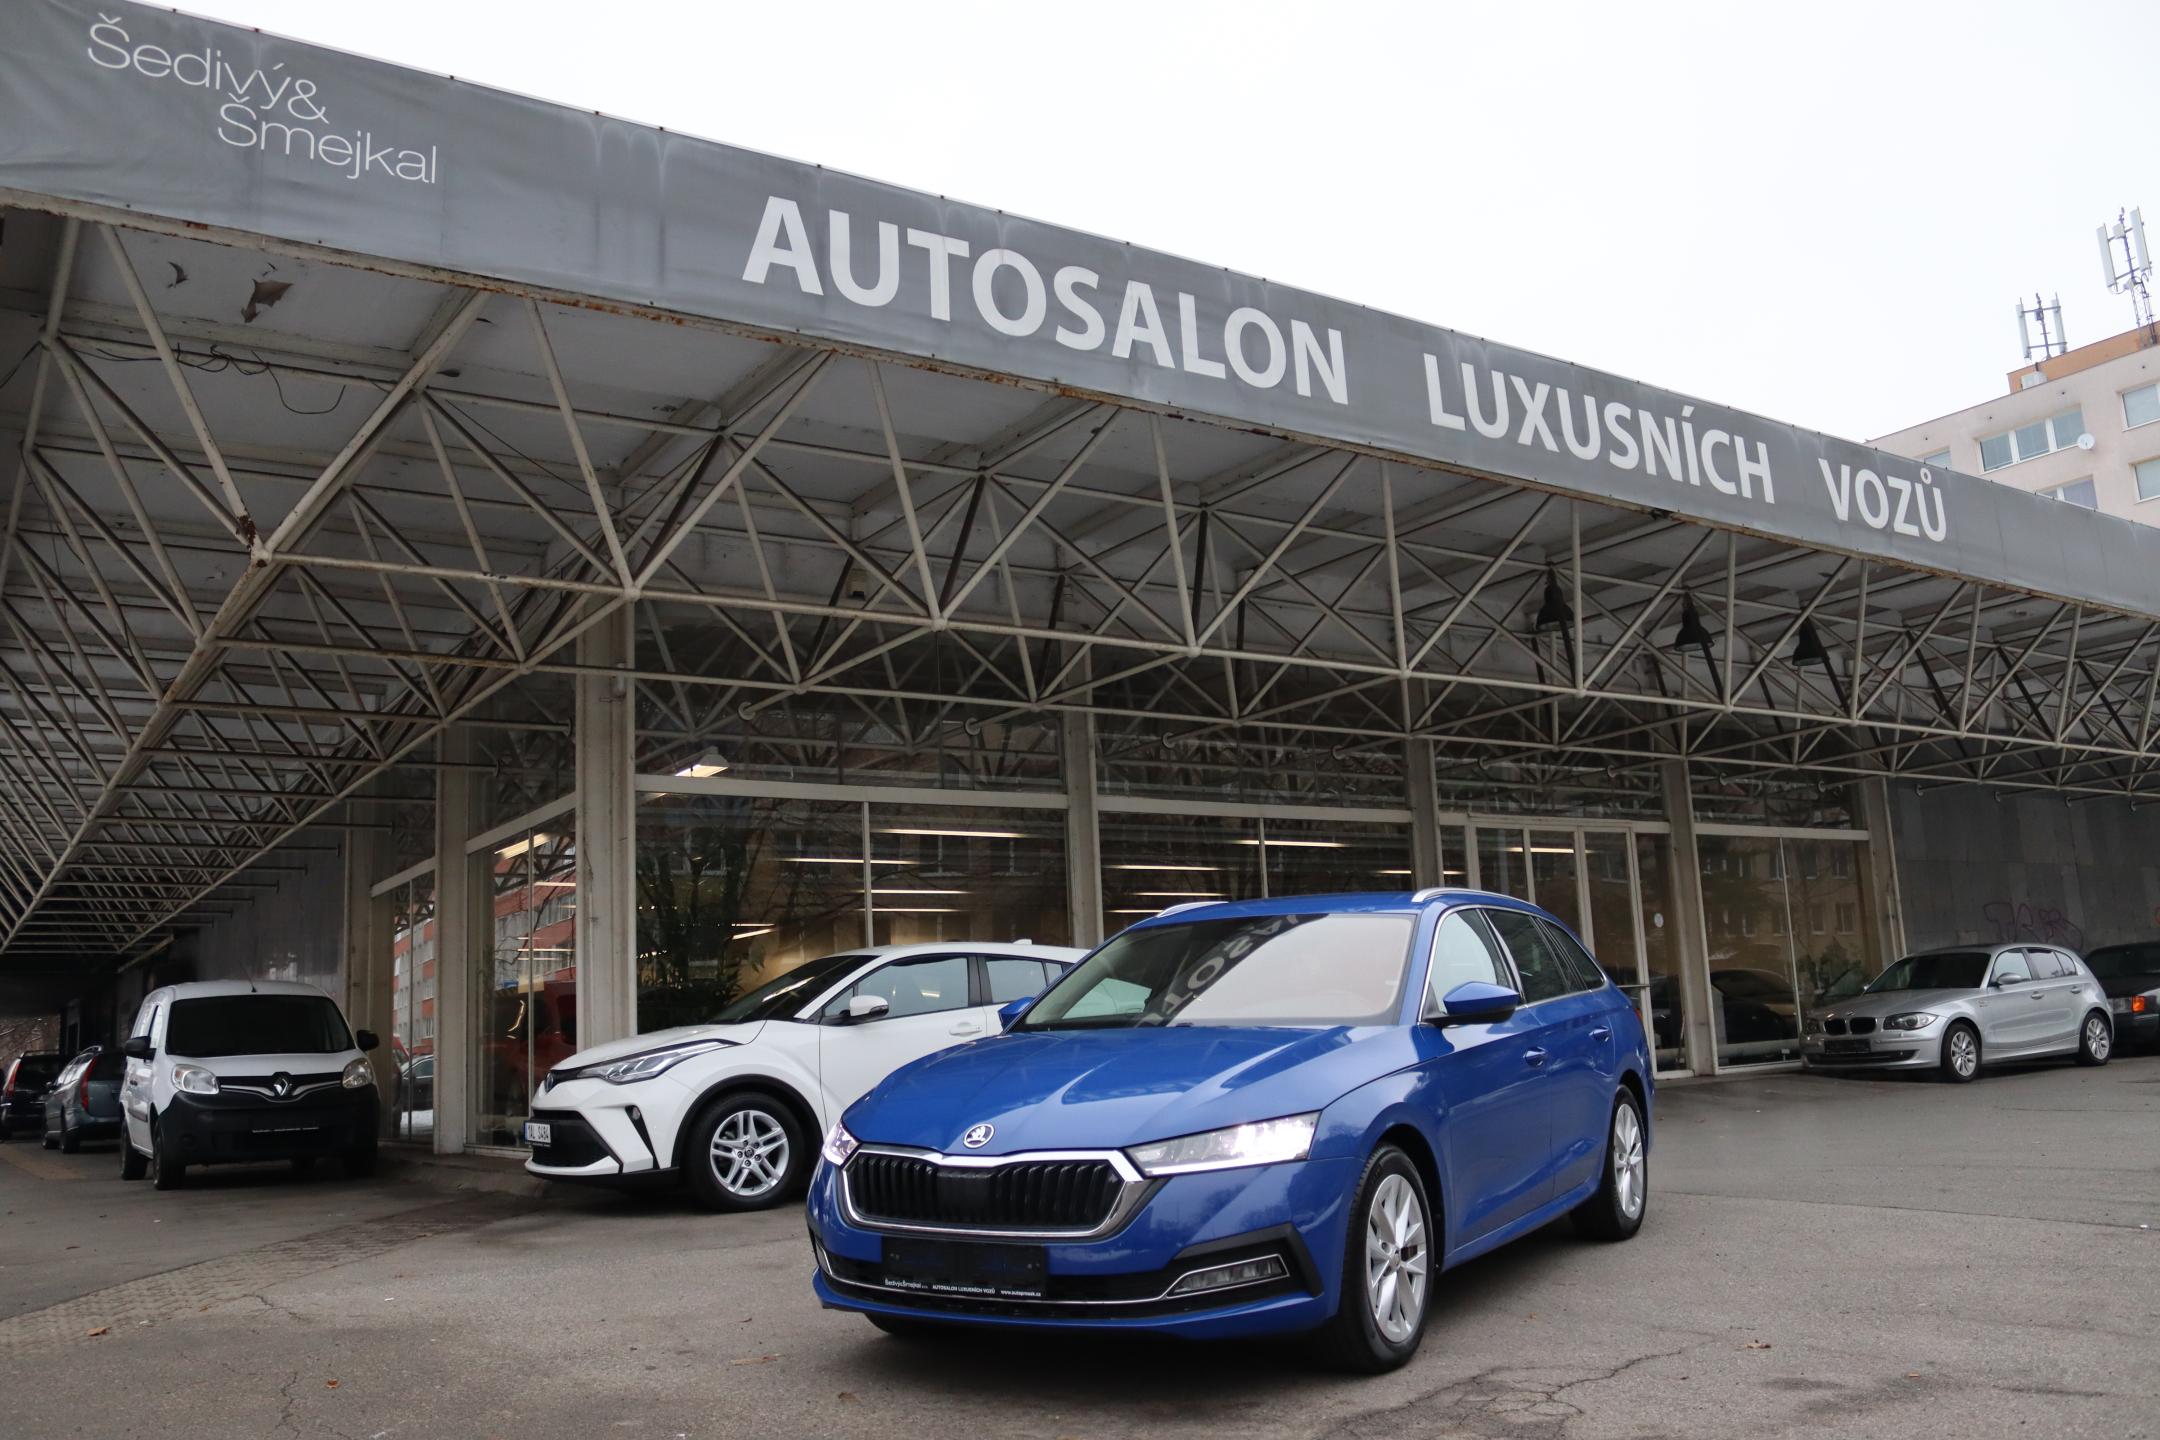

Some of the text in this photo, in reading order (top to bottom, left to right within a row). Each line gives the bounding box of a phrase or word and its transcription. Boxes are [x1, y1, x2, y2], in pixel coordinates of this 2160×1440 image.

[87, 12, 330, 125] Šedivý&
[217, 92, 438, 184] Šmejkal
[742, 196, 1948, 543] AUTOSALON LUXUSNÍCH VOZŮ
